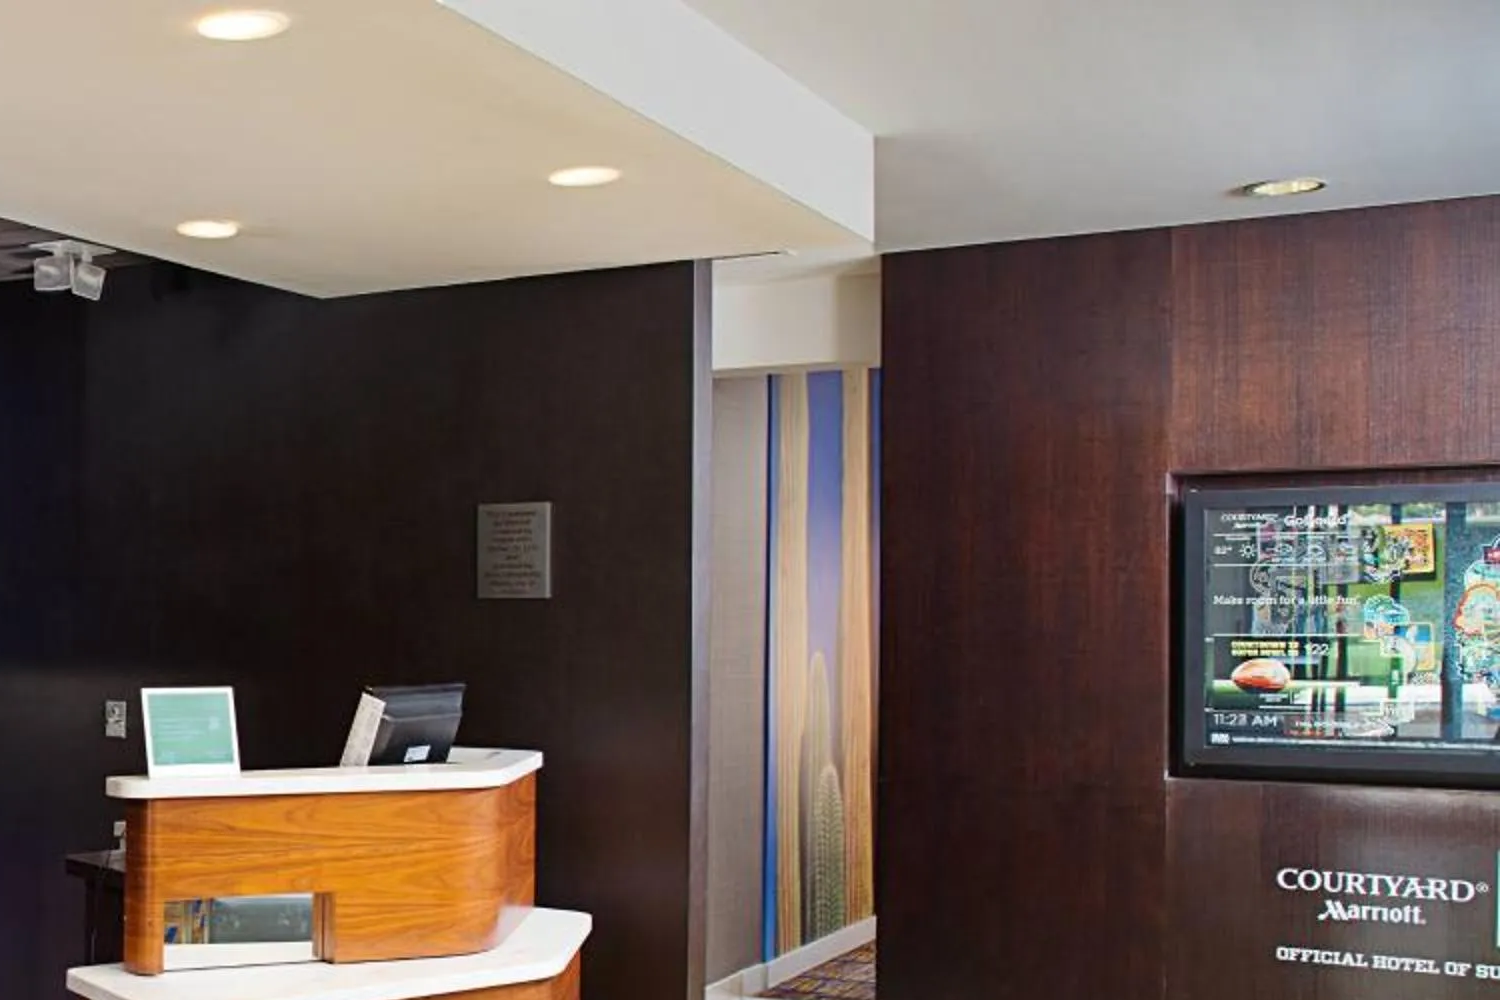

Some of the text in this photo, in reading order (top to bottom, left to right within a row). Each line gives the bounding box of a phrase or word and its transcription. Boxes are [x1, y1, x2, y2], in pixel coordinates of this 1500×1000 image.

[1213, 713, 1248, 726] 11:23
[1251, 714, 1279, 727] AM
[1275, 946, 1369, 969] OFFICIAL
[1371, 954, 1441, 975] HOTEL
[1443, 960, 1472, 978] OF
